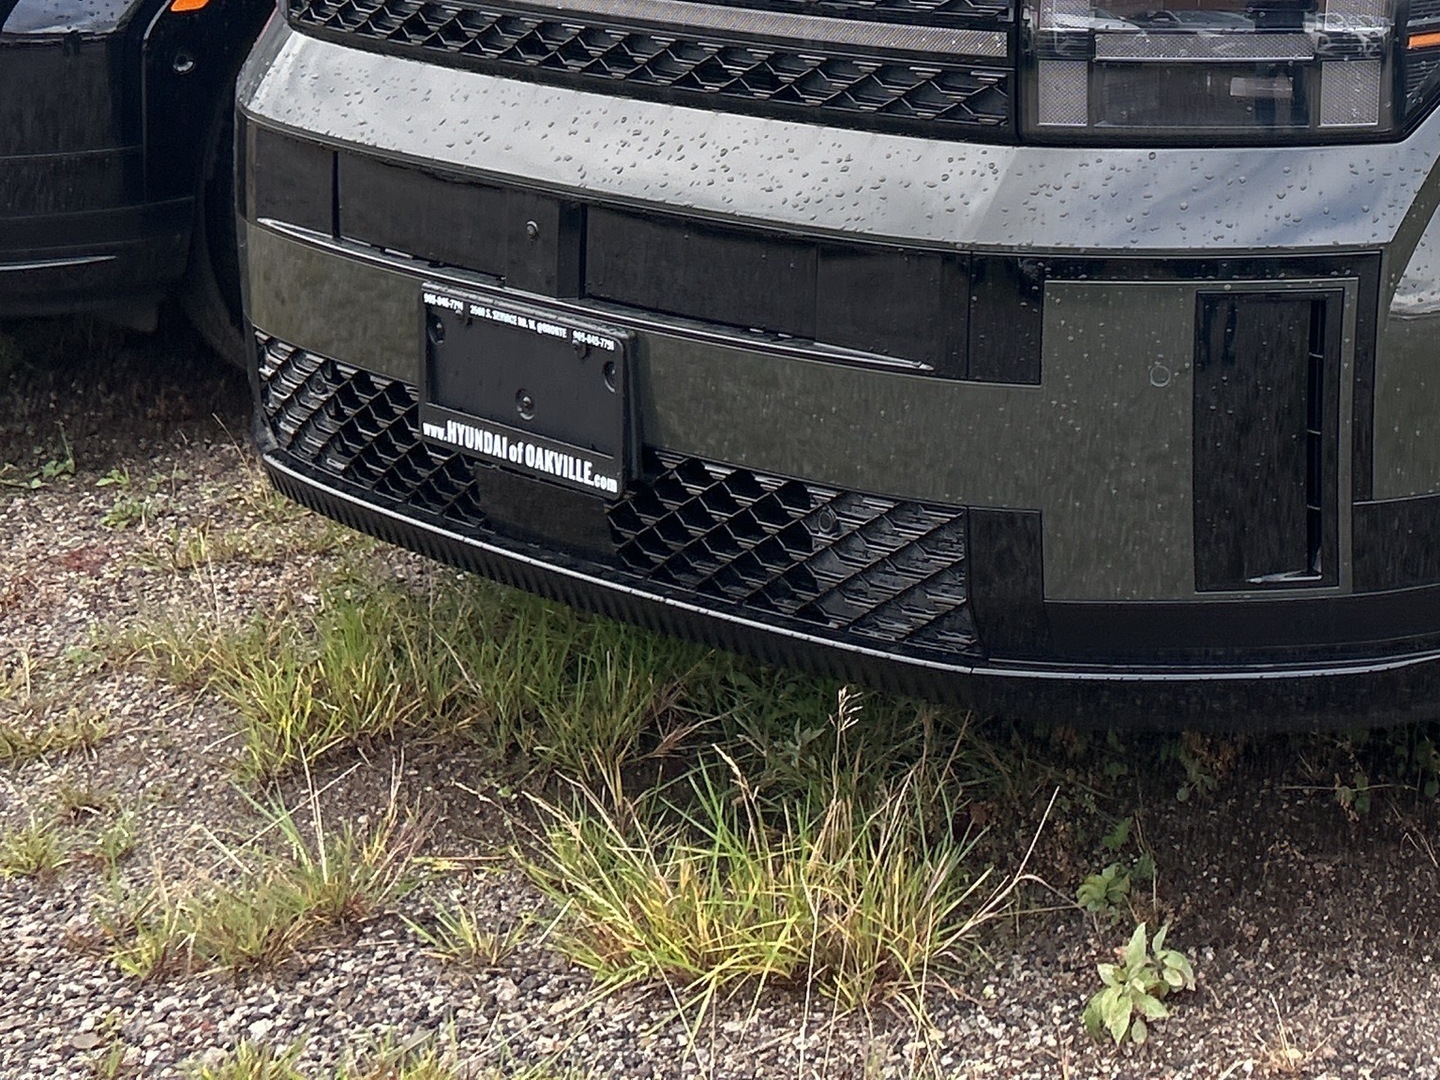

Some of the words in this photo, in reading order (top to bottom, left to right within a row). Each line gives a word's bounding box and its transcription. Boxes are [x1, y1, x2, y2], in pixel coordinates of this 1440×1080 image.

[422, 420, 508, 460] www.HYUNDAI
[508, 439, 524, 464] of
[525, 443, 618, 493] OAKVILLE.com
